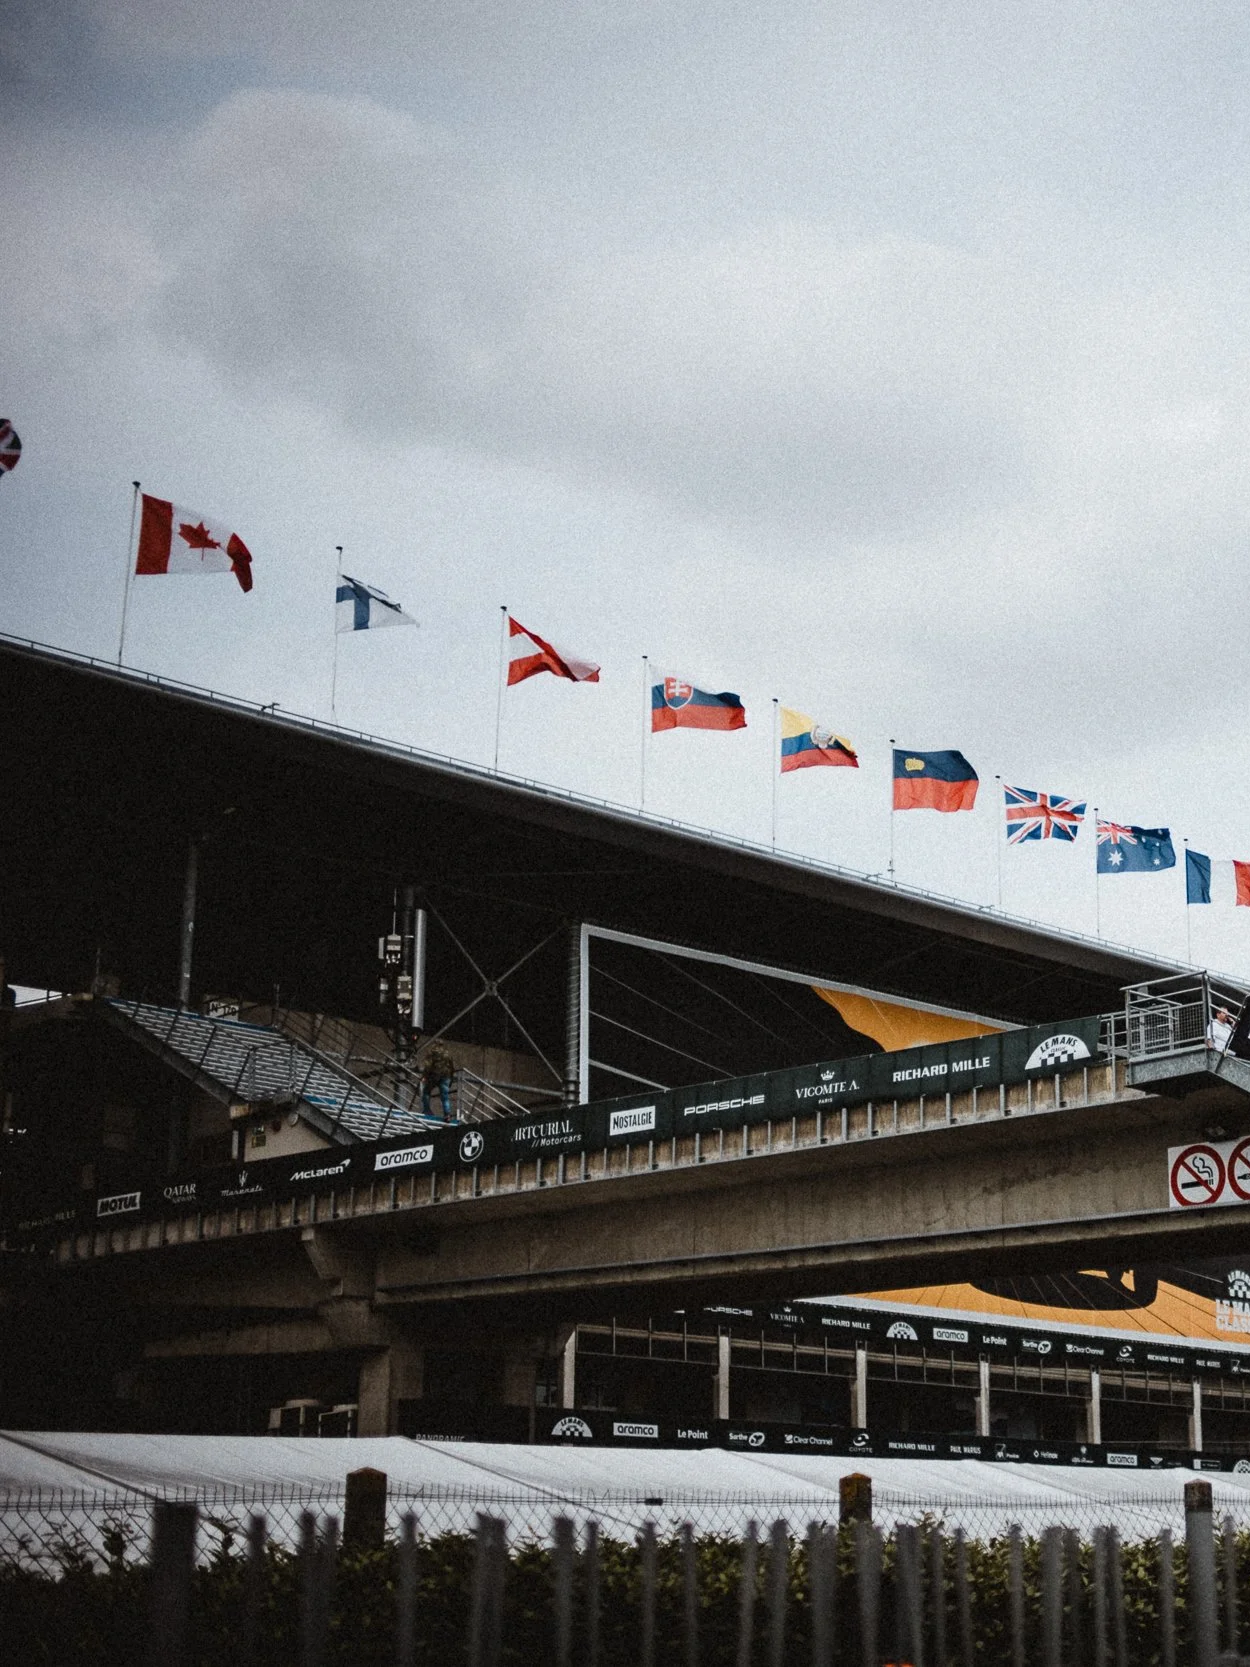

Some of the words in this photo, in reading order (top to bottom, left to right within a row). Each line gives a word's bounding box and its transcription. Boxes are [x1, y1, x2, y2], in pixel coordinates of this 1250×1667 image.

[1040, 1042, 1050, 1053] LE
[1051, 1036, 1078, 1047] MANS
[892, 1063, 948, 1083] RICHARD
[951, 1056, 991, 1073] MILLE
[795, 1080, 847, 1099] VICOMTE
[683, 1094, 765, 1117] PORSCHE
[612, 1111, 652, 1130] NOSTALGIE
[380, 1148, 428, 1167] aramco
[289, 1164, 345, 1182] McLaren
[163, 1183, 197, 1199] QATAR
[99, 1195, 138, 1214] MOTUL
[1215, 1298, 1230, 1315] LE
[821, 1318, 850, 1327] RICHARD
[851, 1321, 871, 1330] MILLE
[936, 1330, 965, 1340] aramco
[982, 1335, 990, 1344] Le
[990, 1336, 1007, 1346] Point
[617, 1425, 654, 1436] aramco
[677, 1429, 686, 1438] Le
[687, 1429, 708, 1440] Point
[729, 1432, 748, 1441] Sarthe
[793, 1437, 808, 1445] Clear
[808, 1436, 833, 1446] Channel
[888, 1442, 916, 1450] RICHARD
[917, 1443, 936, 1452] MILLE
[1109, 1455, 1135, 1464] aramco
